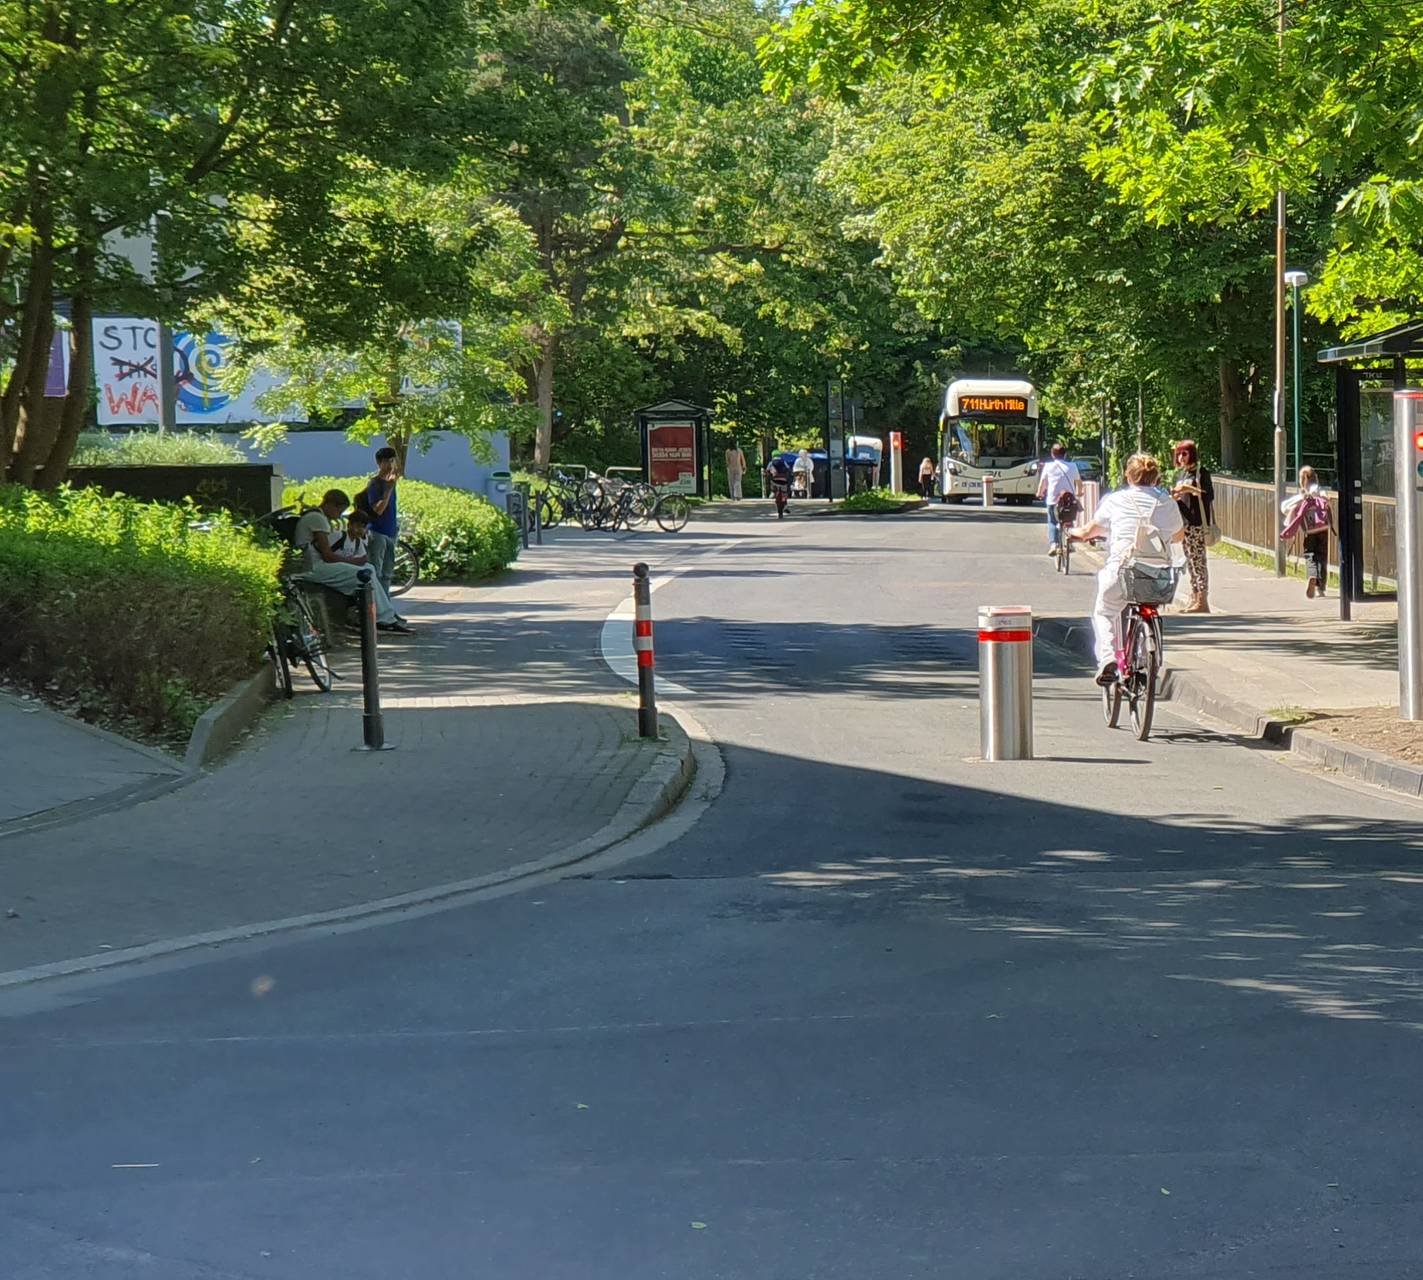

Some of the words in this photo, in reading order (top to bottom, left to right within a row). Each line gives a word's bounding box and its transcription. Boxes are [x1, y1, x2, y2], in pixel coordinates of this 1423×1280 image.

[99, 326, 156, 351] STO
[104, 383, 159, 416] WA
[962, 399, 979, 411] 711
